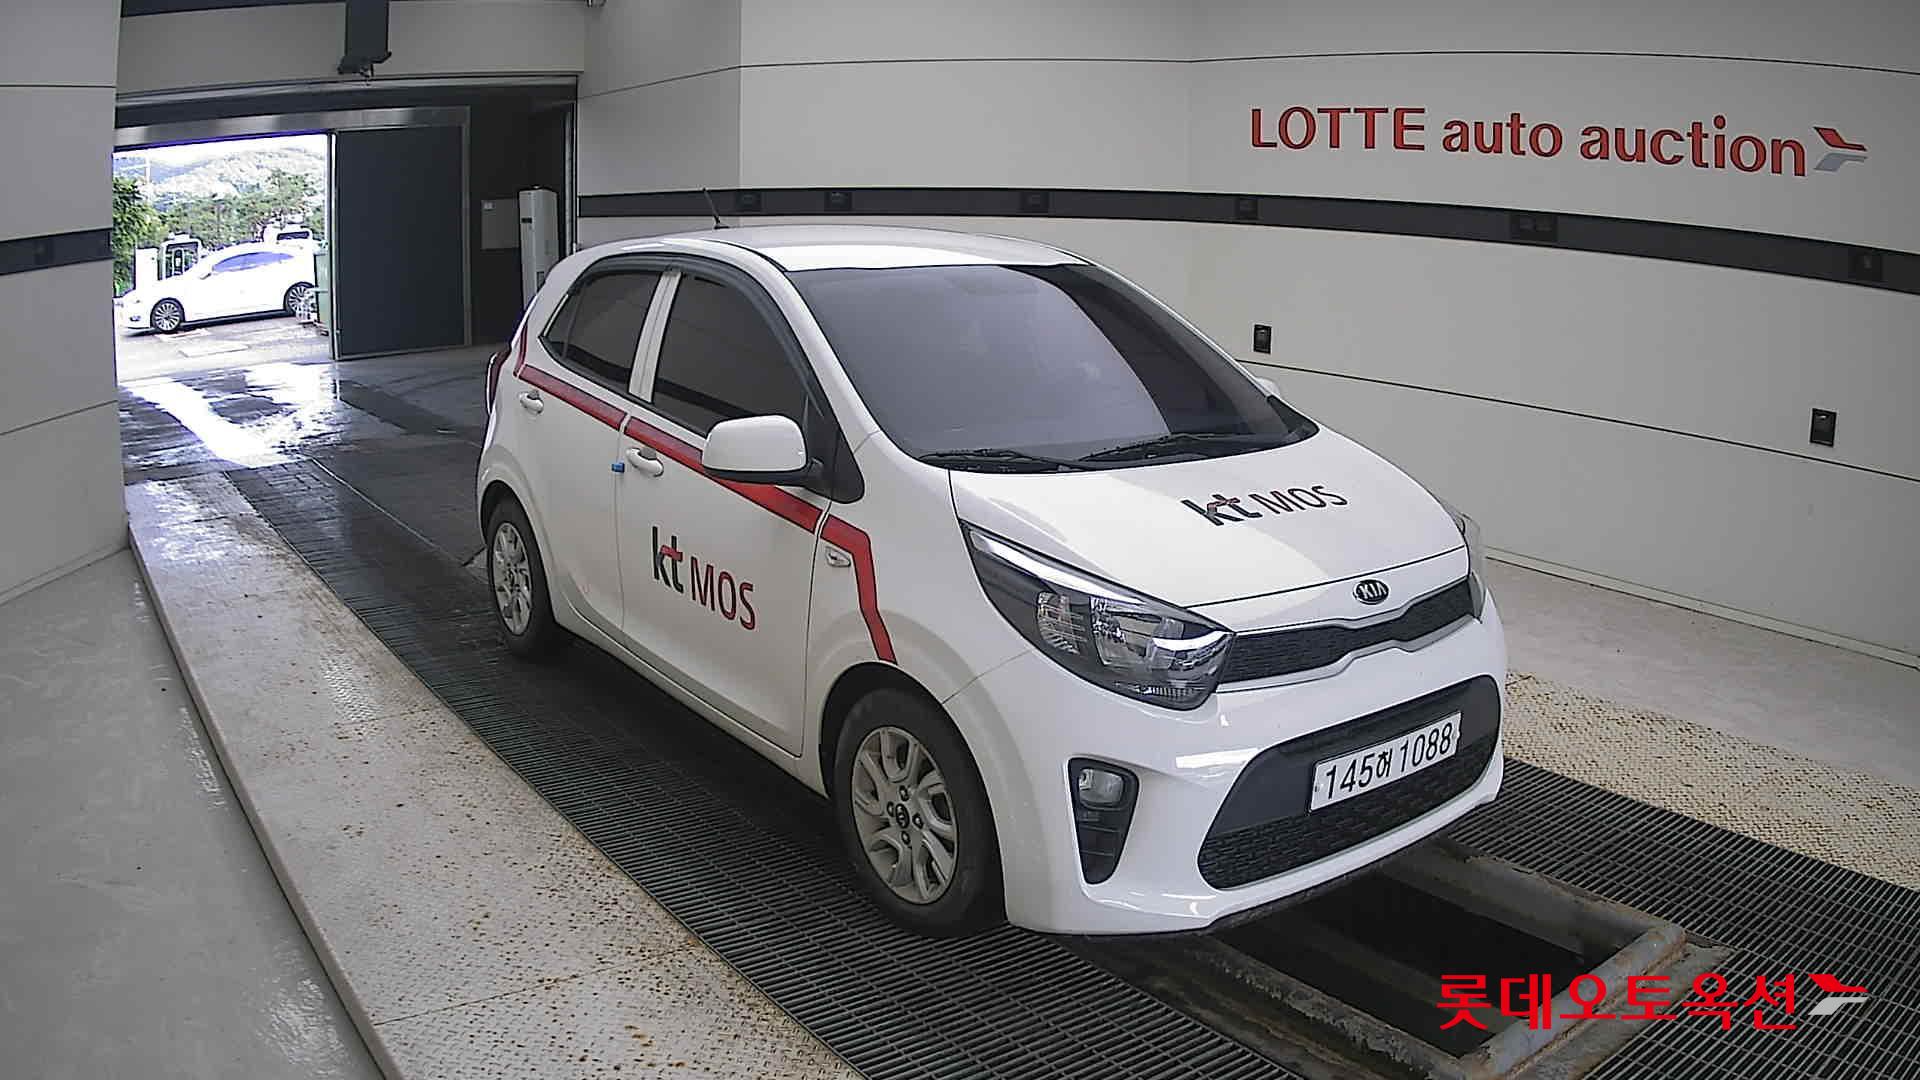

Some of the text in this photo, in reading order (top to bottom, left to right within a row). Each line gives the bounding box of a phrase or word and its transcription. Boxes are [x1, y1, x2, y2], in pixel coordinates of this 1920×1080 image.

[1251, 107, 1807, 177] LOTTE auto auction
[1180, 485, 1348, 526] kt MOS
[652, 526, 755, 630] kt MOS
[1359, 582, 1387, 599] KIA
[1326, 722, 1453, 800] 145허 1088
